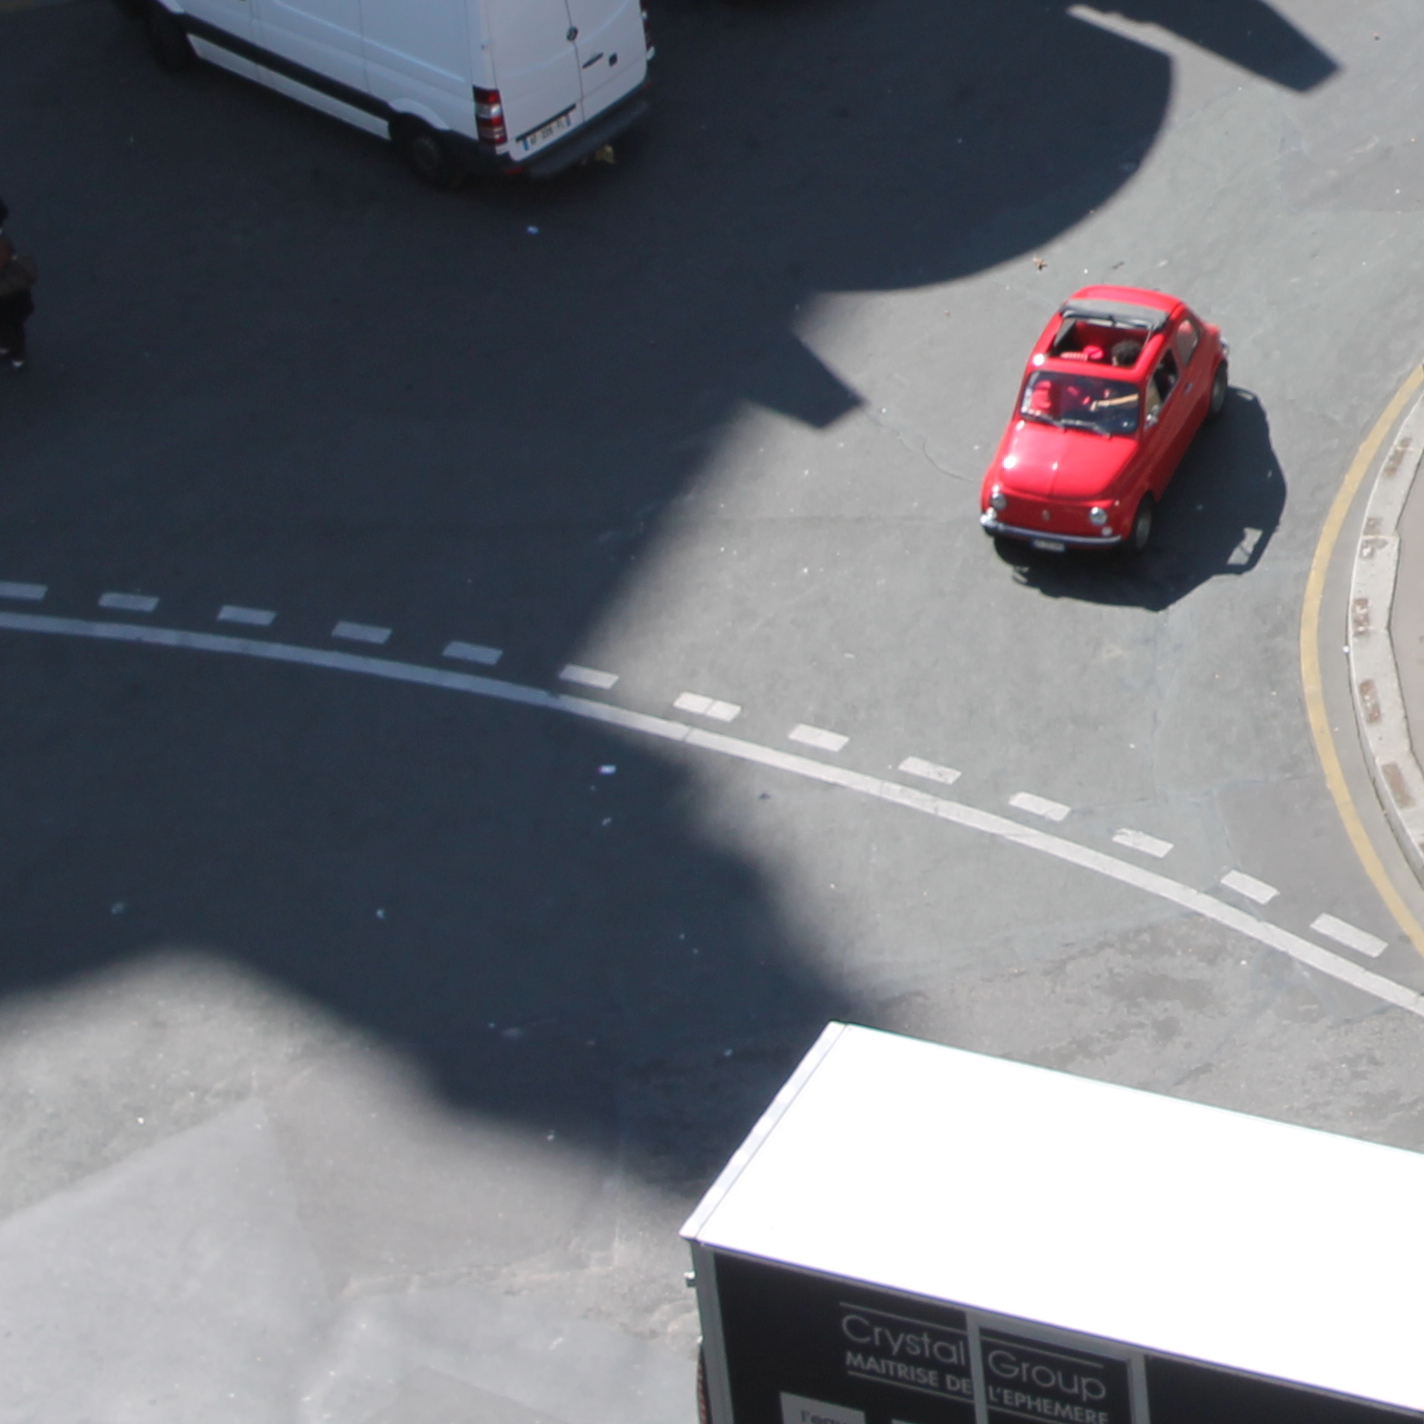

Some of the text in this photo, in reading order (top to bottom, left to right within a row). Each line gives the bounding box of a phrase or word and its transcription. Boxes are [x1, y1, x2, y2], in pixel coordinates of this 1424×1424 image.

[841, 1314, 1107, 1402] Crystal Group
[846, 1351, 1109, 1424] MAITRISE DE L'EPHEMERE
